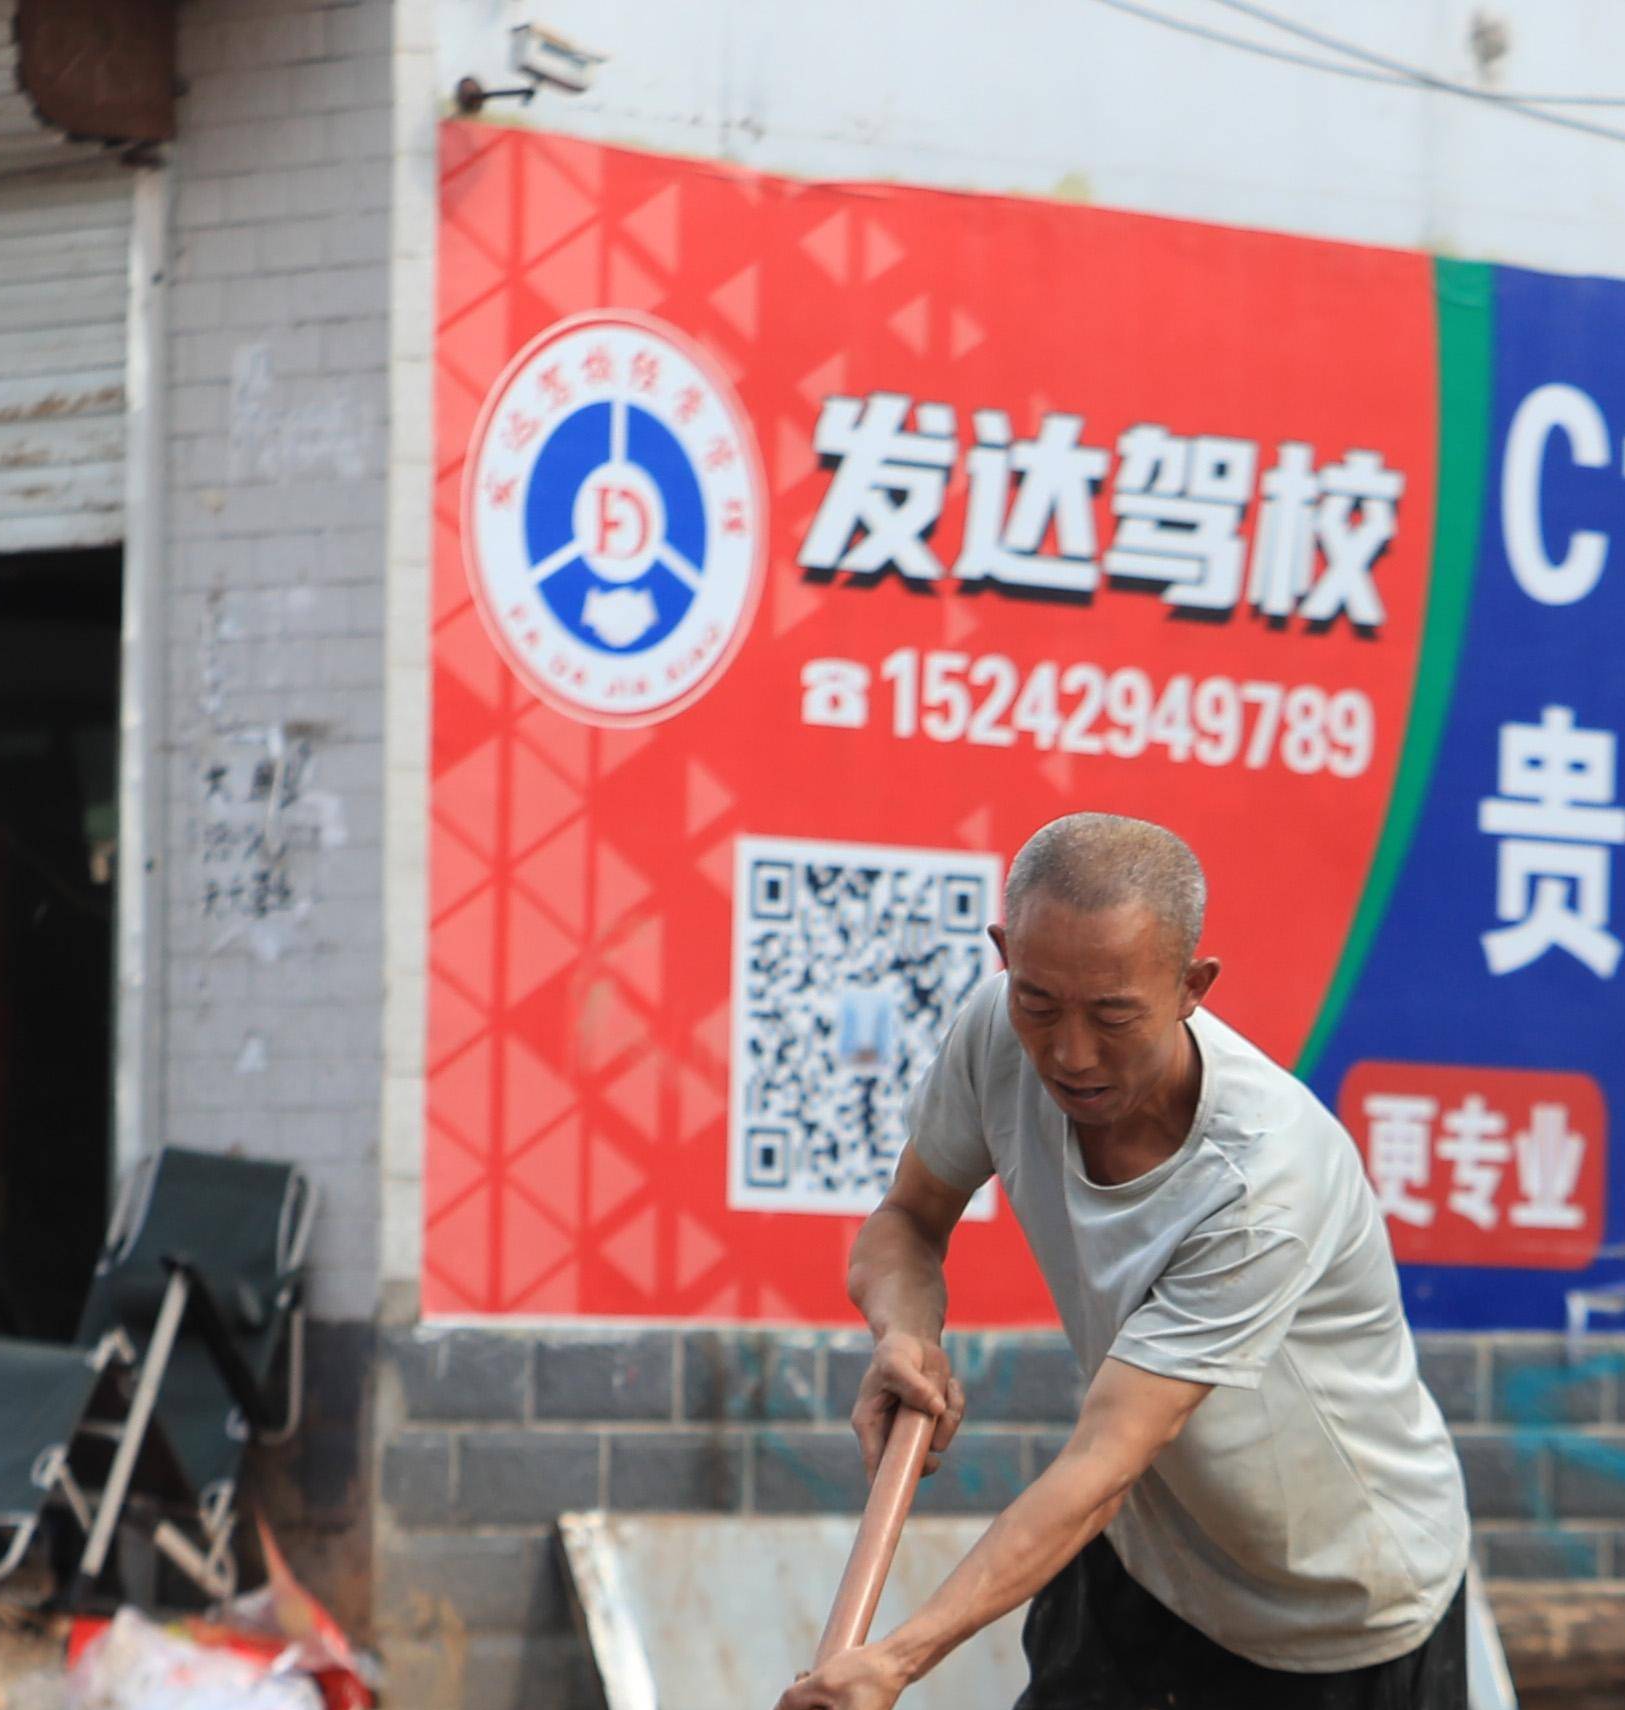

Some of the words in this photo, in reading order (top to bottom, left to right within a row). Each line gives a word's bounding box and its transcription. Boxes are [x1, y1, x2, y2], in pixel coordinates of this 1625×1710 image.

[797, 391, 1407, 632] 发达驾校
[879, 646, 1376, 779] 15242949789
[1362, 1091, 1586, 1230] 更专业
